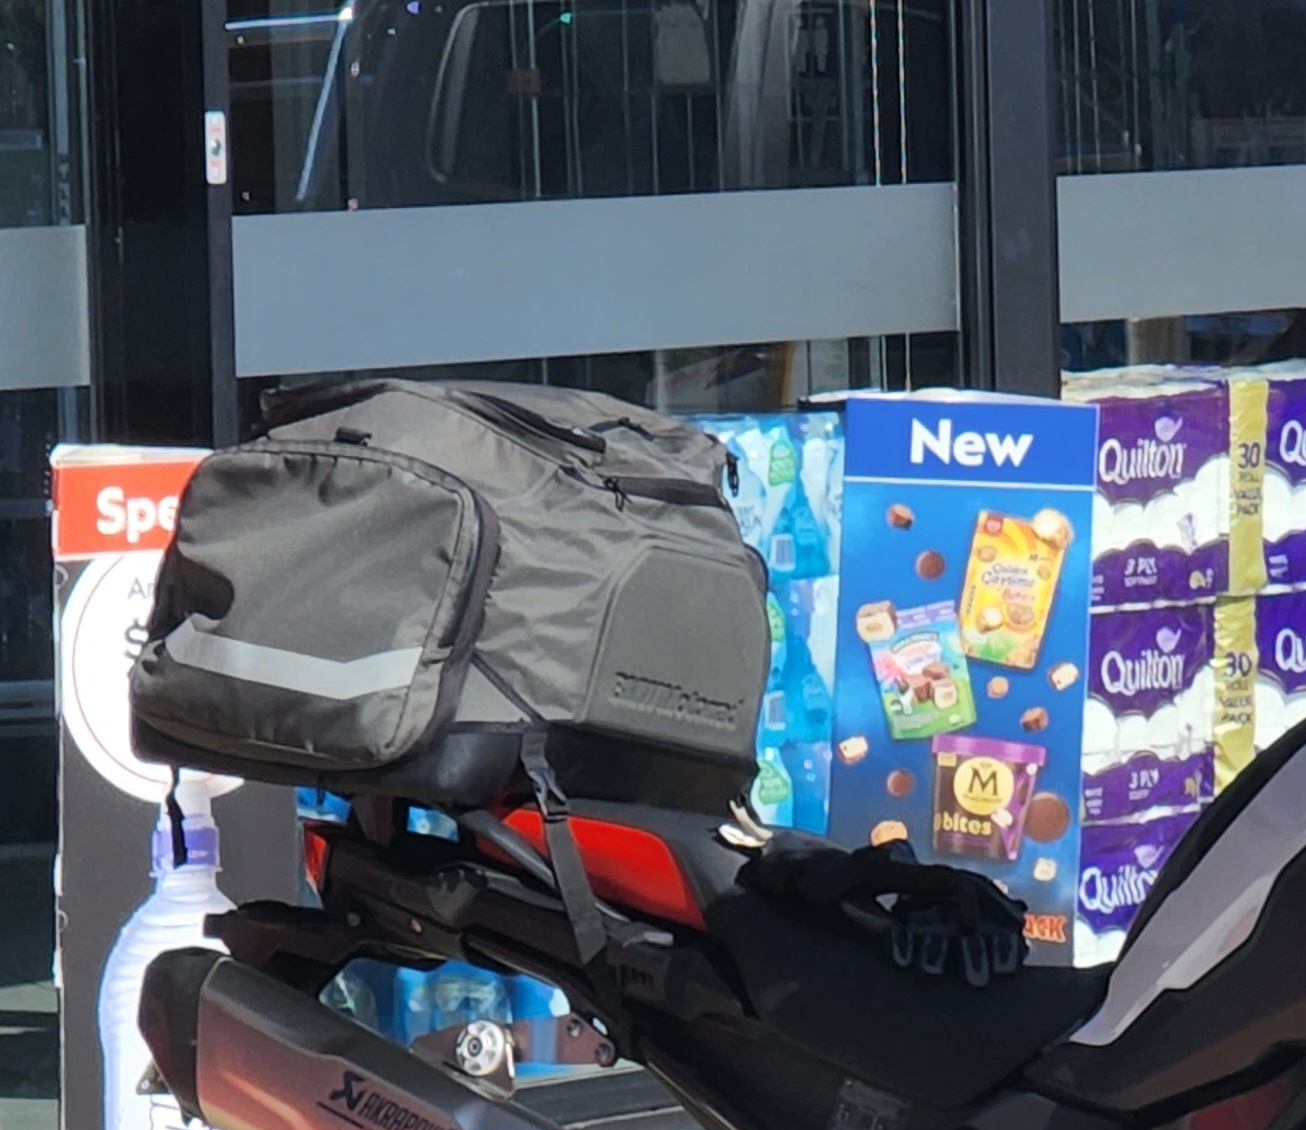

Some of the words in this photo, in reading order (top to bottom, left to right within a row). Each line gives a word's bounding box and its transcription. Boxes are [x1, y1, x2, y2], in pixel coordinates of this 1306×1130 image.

[910, 418, 1034, 467] New
[1237, 442, 1261, 468] 30
[1099, 438, 1185, 485] Quilton
[1101, 648, 1184, 696] Quilton
[1223, 652, 1252, 678] 30
[968, 765, 998, 796] M
[943, 810, 992, 836] bites
